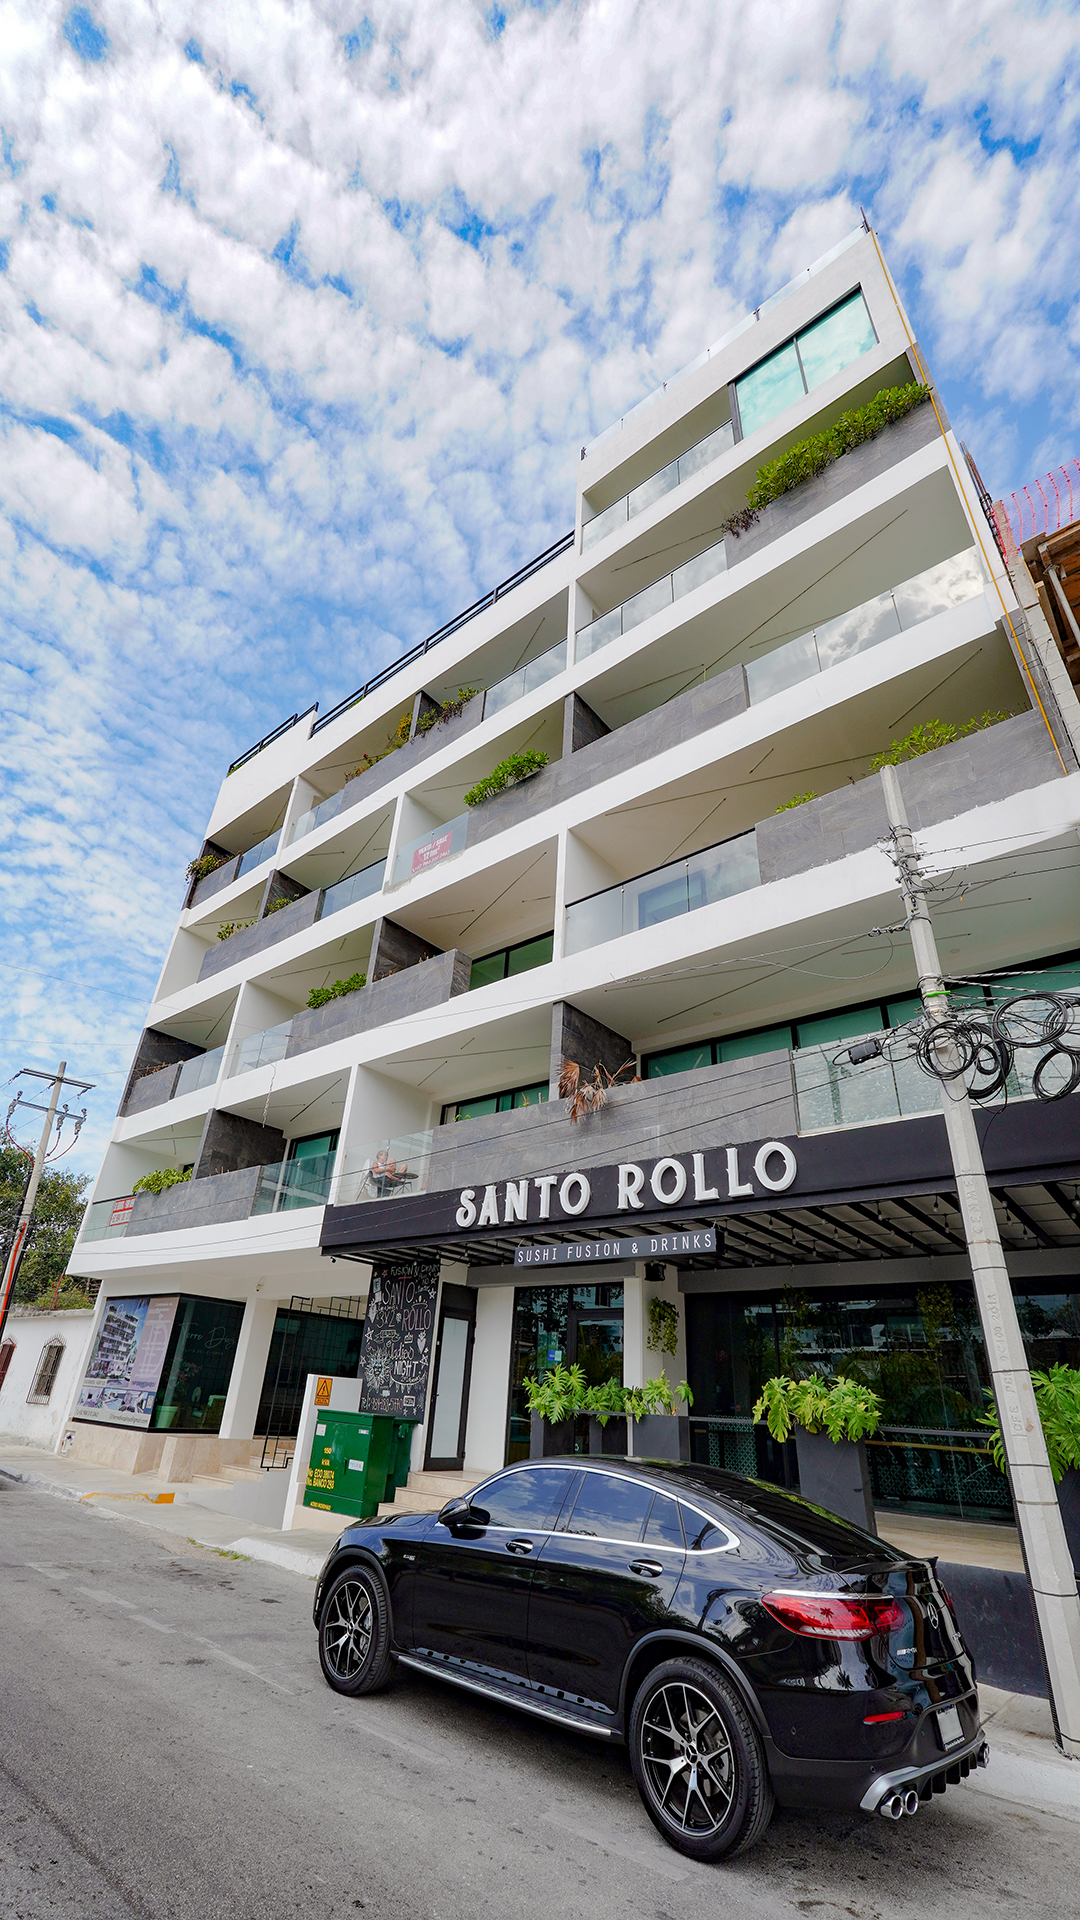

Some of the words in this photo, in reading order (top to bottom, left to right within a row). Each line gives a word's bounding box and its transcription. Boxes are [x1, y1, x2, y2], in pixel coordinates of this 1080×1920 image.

[455, 1172, 591, 1229] SANTO
[617, 1141, 798, 1211] ROLLO
[518, 1247, 557, 1263] SUSHI
[566, 1242, 621, 1259] FUSION
[631, 1241, 639, 1254] &
[650, 1233, 712, 1254] DRINKS
[381, 1274, 415, 1308] SANTO
[402, 1309, 432, 1331] ROLLO
[393, 1361, 419, 1377] NIGHT
[1008, 1405, 1024, 1432] CFE
[313, 1477, 327, 1488] BANCO
[314, 1468, 323, 1478] ECO
